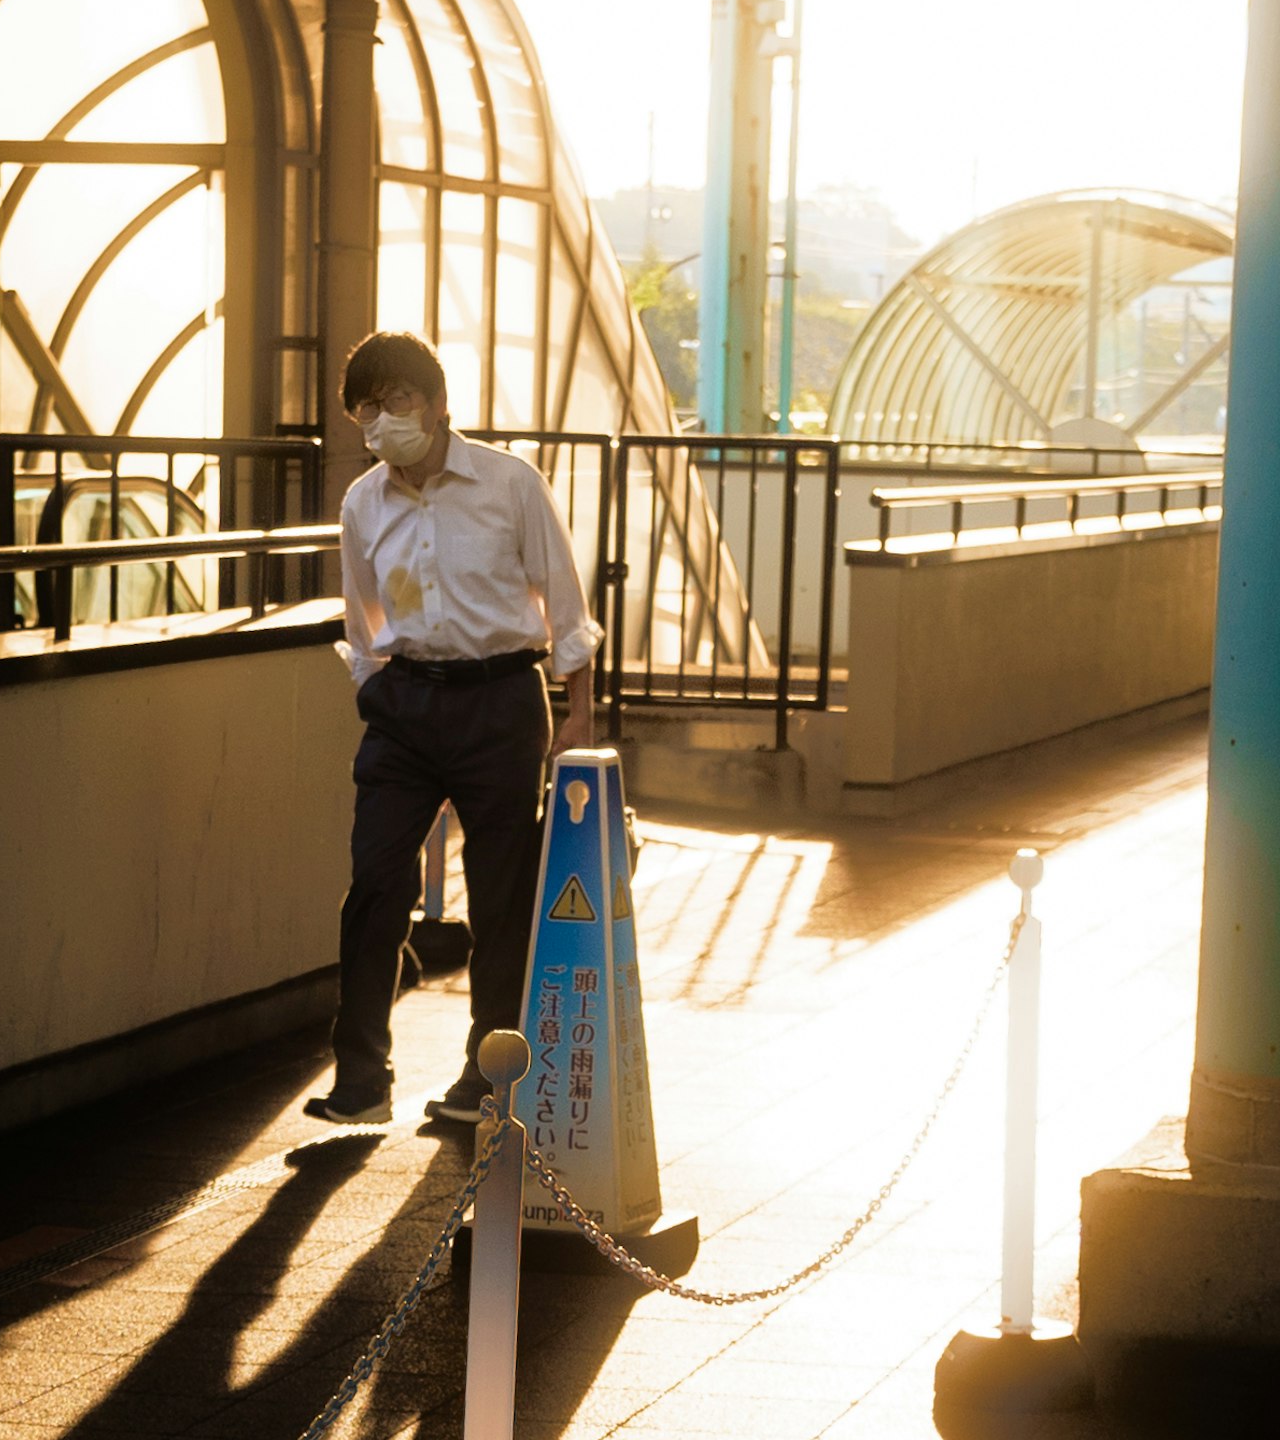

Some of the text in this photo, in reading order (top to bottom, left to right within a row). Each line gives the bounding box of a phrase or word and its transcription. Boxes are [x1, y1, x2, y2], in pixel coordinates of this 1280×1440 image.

[534, 965, 566, 1163] ご注意ください。
[568, 967, 599, 1150] 頭上の雨漏りに
